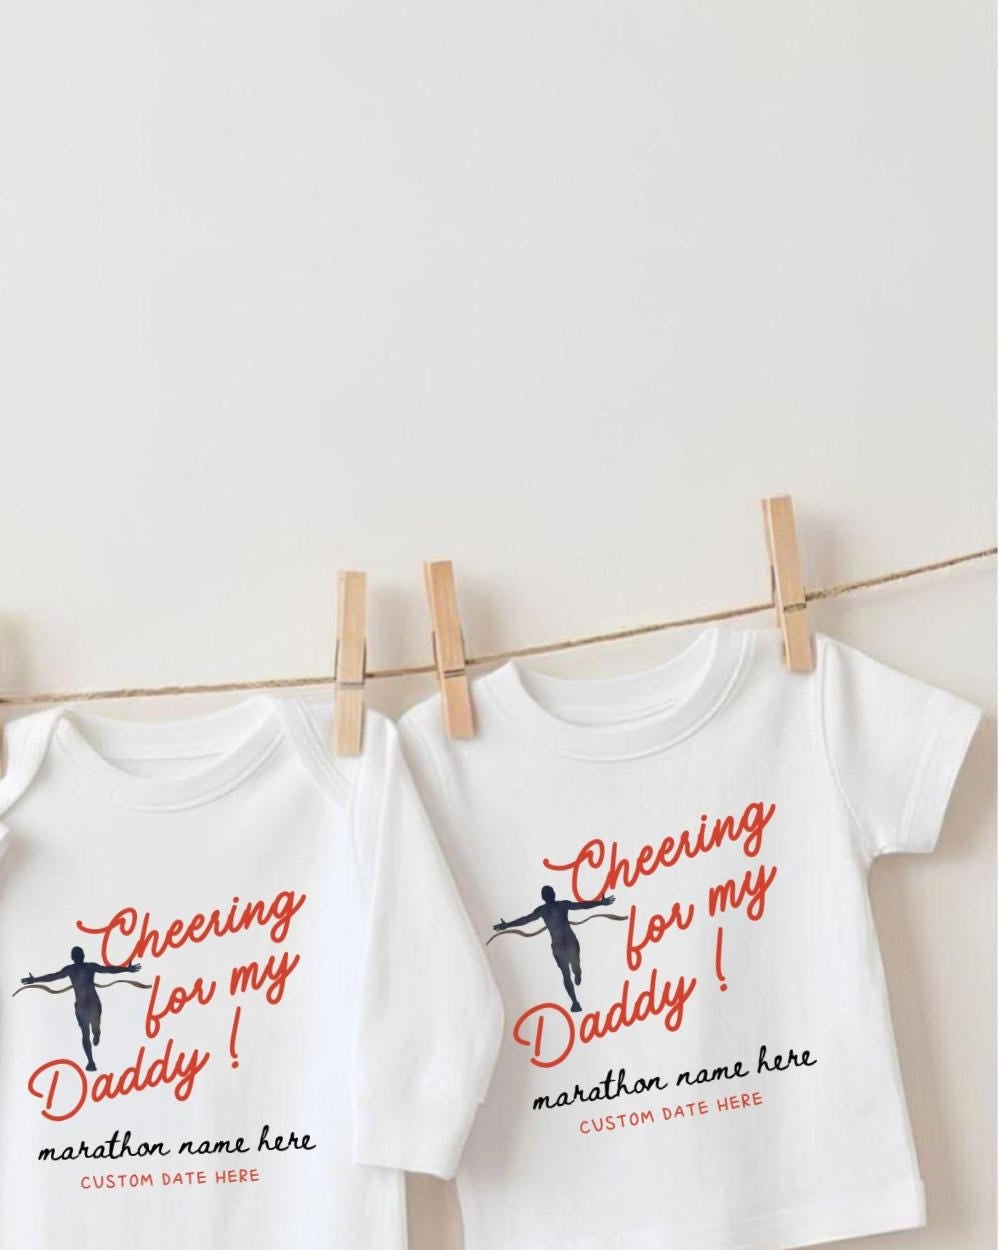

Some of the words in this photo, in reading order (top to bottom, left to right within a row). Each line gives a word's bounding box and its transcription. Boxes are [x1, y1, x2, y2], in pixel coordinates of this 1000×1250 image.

[542, 801, 777, 903] Cheering
[75, 890, 307, 968] Cheering
[625, 902, 696, 972] for
[708, 864, 778, 922] my
[144, 974, 217, 1040] for
[229, 951, 301, 1006] my
[512, 968, 697, 1069] Daddy
[27, 1038, 211, 1123] Daddy
[532, 1068, 669, 1110] marathon
[675, 1061, 750, 1087] name
[756, 1044, 818, 1074] here
[578, 1110, 655, 1135] CUSTOM
[662, 1101, 710, 1121] DATE
[716, 1091, 764, 1113] HERE
[37, 1130, 172, 1161] marathon
[178, 1137, 251, 1155] name
[257, 1124, 317, 1152] here
[80, 1173, 154, 1189] CUSTOM
[161, 1171, 207, 1186] DATE
[215, 1168, 261, 1184] HERE
